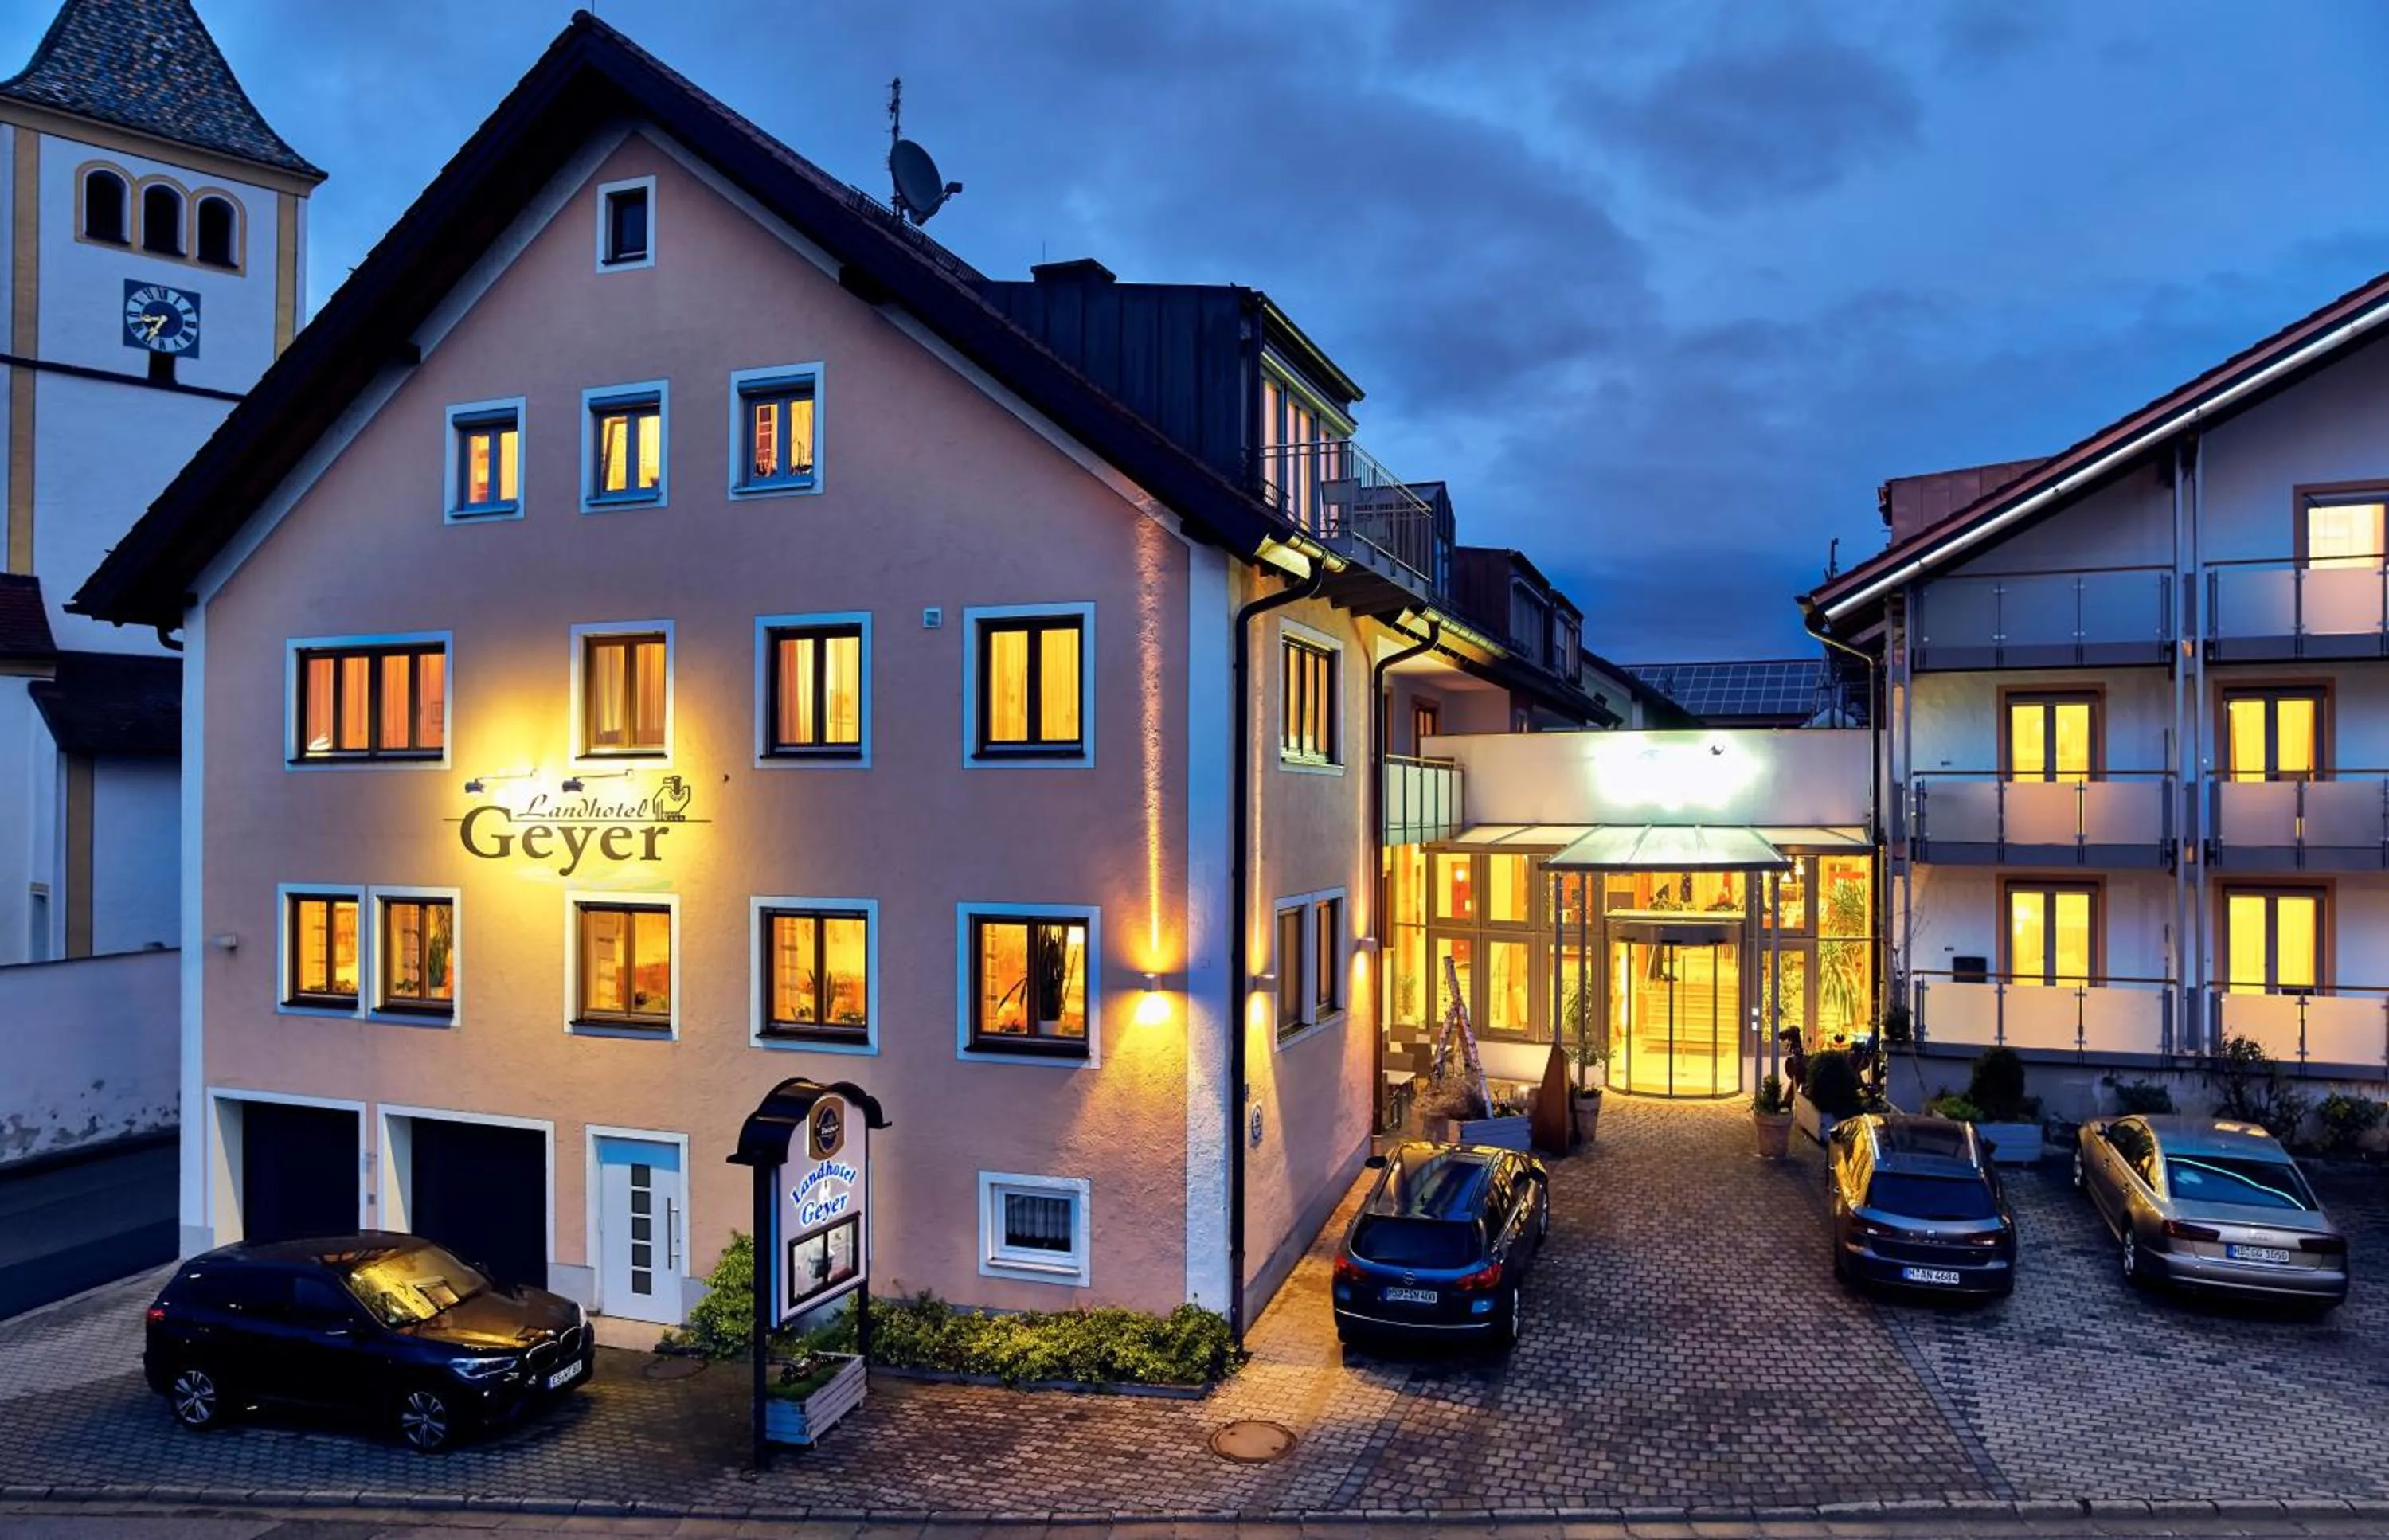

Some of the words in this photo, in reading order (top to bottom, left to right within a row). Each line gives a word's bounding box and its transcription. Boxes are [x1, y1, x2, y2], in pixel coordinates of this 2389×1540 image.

[517, 793, 648, 819] Landhotel
[459, 805, 670, 877] Geyer
[791, 1159, 857, 1204] Landhotel
[801, 1194, 848, 1225] Geyer
